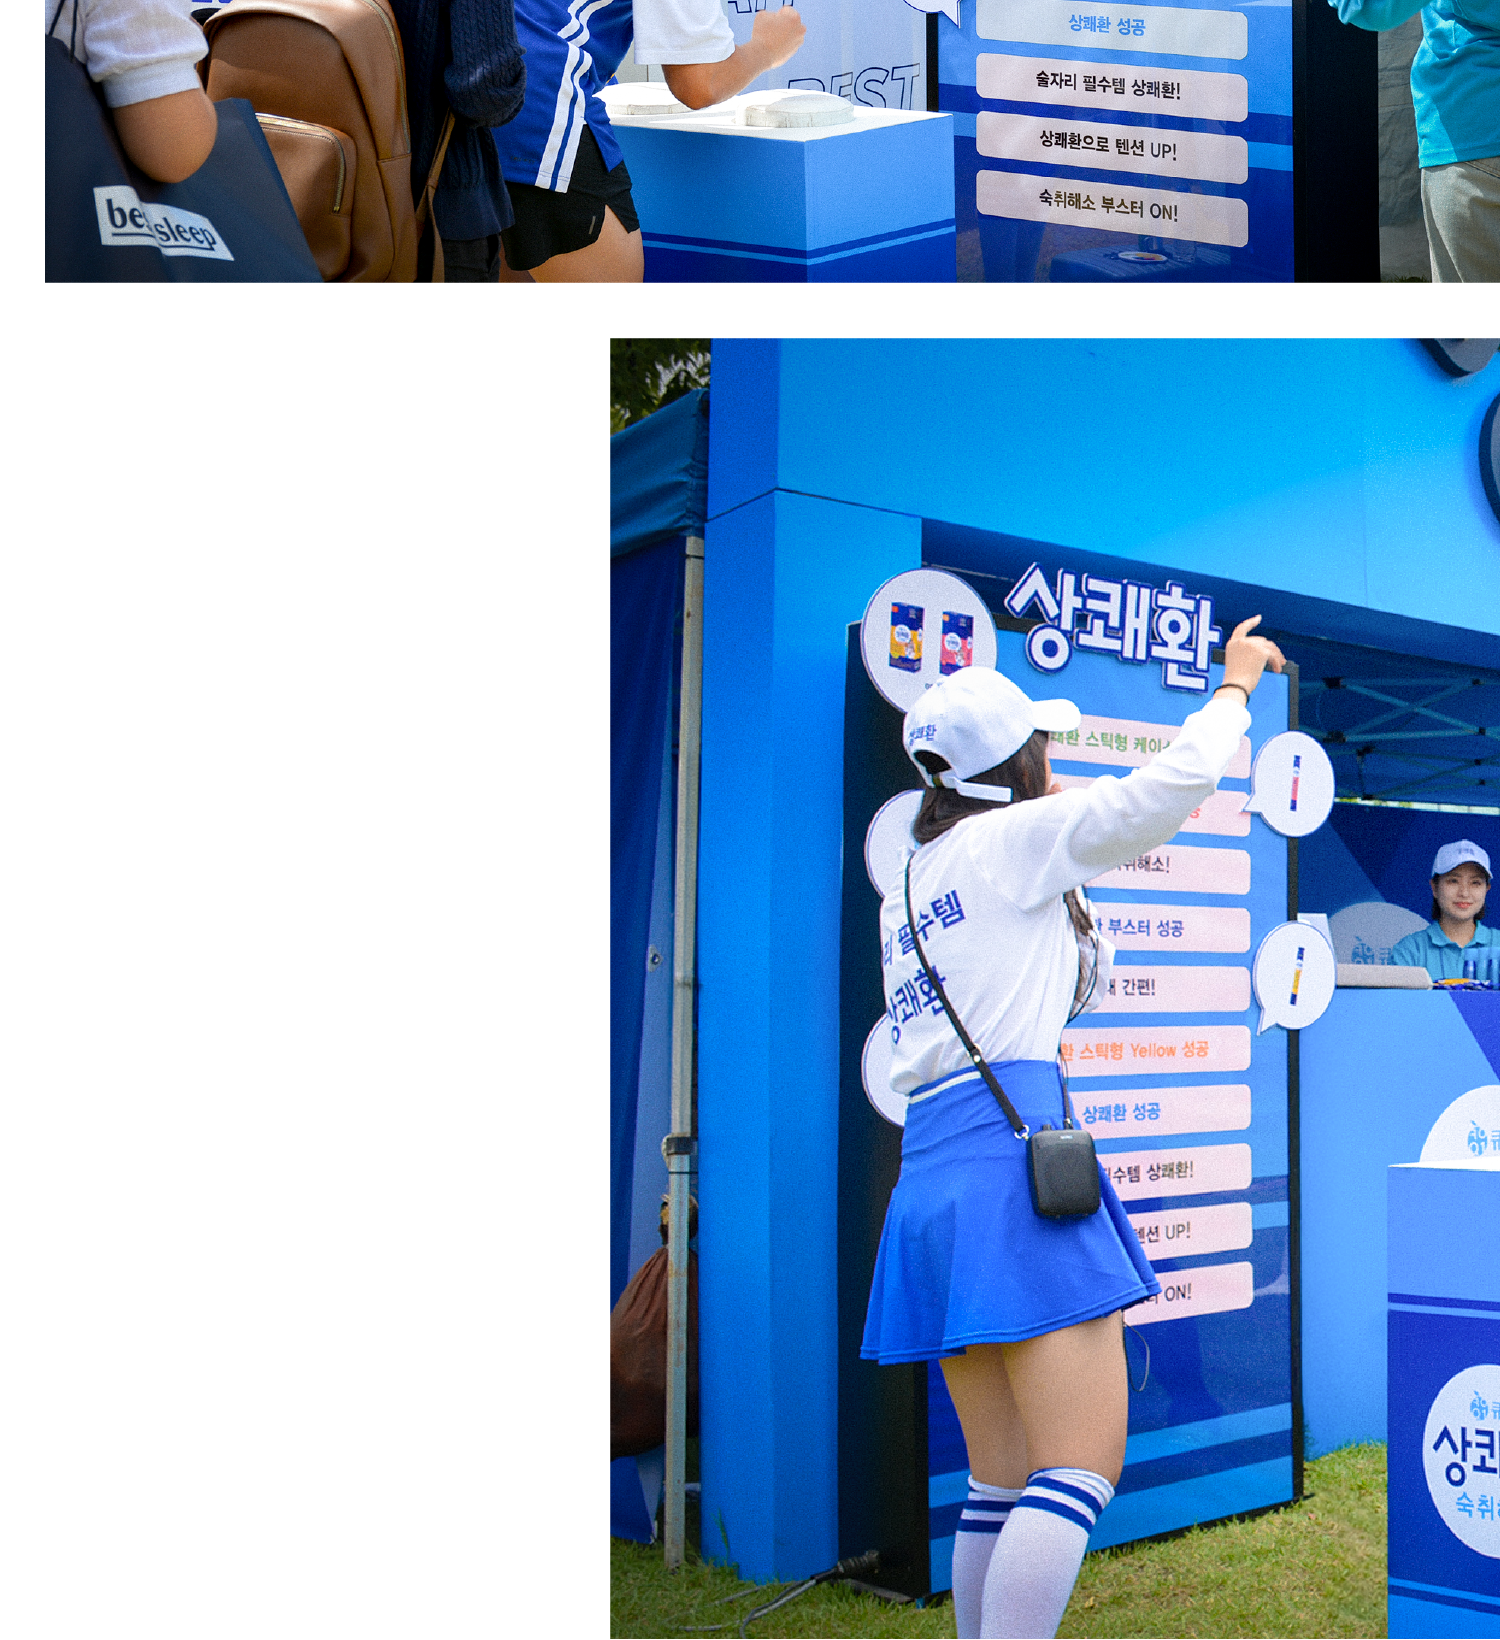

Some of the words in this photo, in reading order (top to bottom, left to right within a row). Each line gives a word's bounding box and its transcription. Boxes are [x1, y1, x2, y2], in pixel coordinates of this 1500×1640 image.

[1069, 14, 1111, 33] 상쾌환
[1117, 18, 1146, 36] 성공
[1037, 70, 1077, 90] 술자리
[1083, 75, 1125, 94] 필수템
[1131, 79, 1181, 99] 상쾌환!
[1040, 130, 1109, 152] 상쾌환으로
[1116, 137, 1145, 156] 텐션
[1150, 143, 1177, 161] UP!
[1040, 189, 1096, 211] 숙취해소
[1101, 195, 1144, 218] 부스터
[1150, 203, 1178, 222] ON!
[154, 217, 216, 250] sleep
[1004, 562, 1223, 693] 상쾌환
[1086, 732, 1127, 751] 스틱형
[1107, 918, 1150, 937] 부스터
[1156, 919, 1184, 937] 성공
[1122, 978, 1155, 996] 간편!
[1079, 1042, 1122, 1060] 스틱형
[1131, 1043, 1176, 1060] Yellow
[1183, 1041, 1208, 1058] 성공
[1083, 1105, 1126, 1124] 상쾌환
[1133, 1103, 1161, 1120] 성공
[1146, 1161, 1193, 1180] 상쾌환!
[1165, 1223, 1191, 1239] UP!
[1164, 1284, 1192, 1301] ON!
